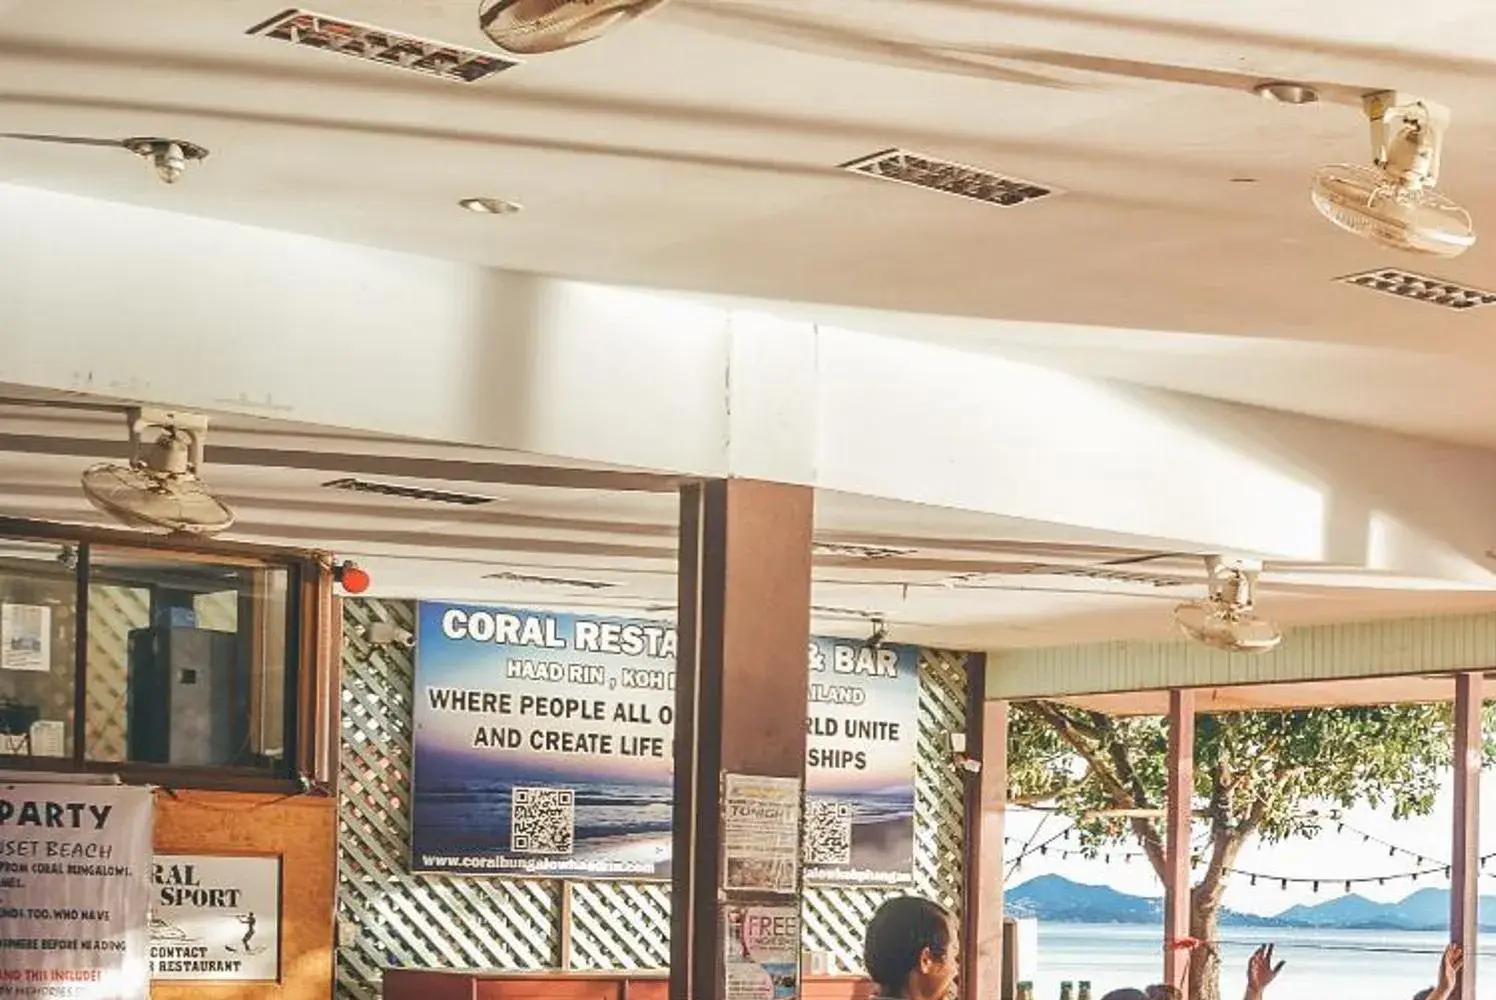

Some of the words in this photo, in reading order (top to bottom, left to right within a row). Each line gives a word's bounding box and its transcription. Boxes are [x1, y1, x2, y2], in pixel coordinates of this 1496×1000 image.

[443, 608, 567, 648] CORAL
[574, 619, 677, 659] RESTA
[833, 643, 898, 678] BAR
[506, 659, 564, 682] HAAD
[568, 663, 605, 685] RIN
[621, 667, 664, 690] KOH
[808, 683, 866, 706] ILAND
[429, 688, 512, 714] WHERE
[520, 695, 605, 720] PEOPLE
[613, 702, 651, 723] ALL
[844, 719, 900, 741] UNITE
[474, 726, 522, 748] AND
[530, 730, 613, 754] CREATE
[620, 735, 663, 757] LIFE
[807, 748, 867, 770] SHIPS
[0, 799, 113, 830] PARTY
[0, 839, 39, 857] SET
[45, 840, 113, 860] BEACH
[32, 863, 64, 874] CORAL
[151, 863, 200, 886] RAL
[160, 887, 242, 908] SPORT
[54, 909, 79, 921] WHO
[81, 910, 110, 922] HAVE
[748, 915, 797, 937] FREE
[41, 939, 78, 951] BEFORE
[81, 941, 126, 951] HEADING
[150, 946, 208, 959] CONTACT
[159, 960, 242, 973] RESTAURANT
